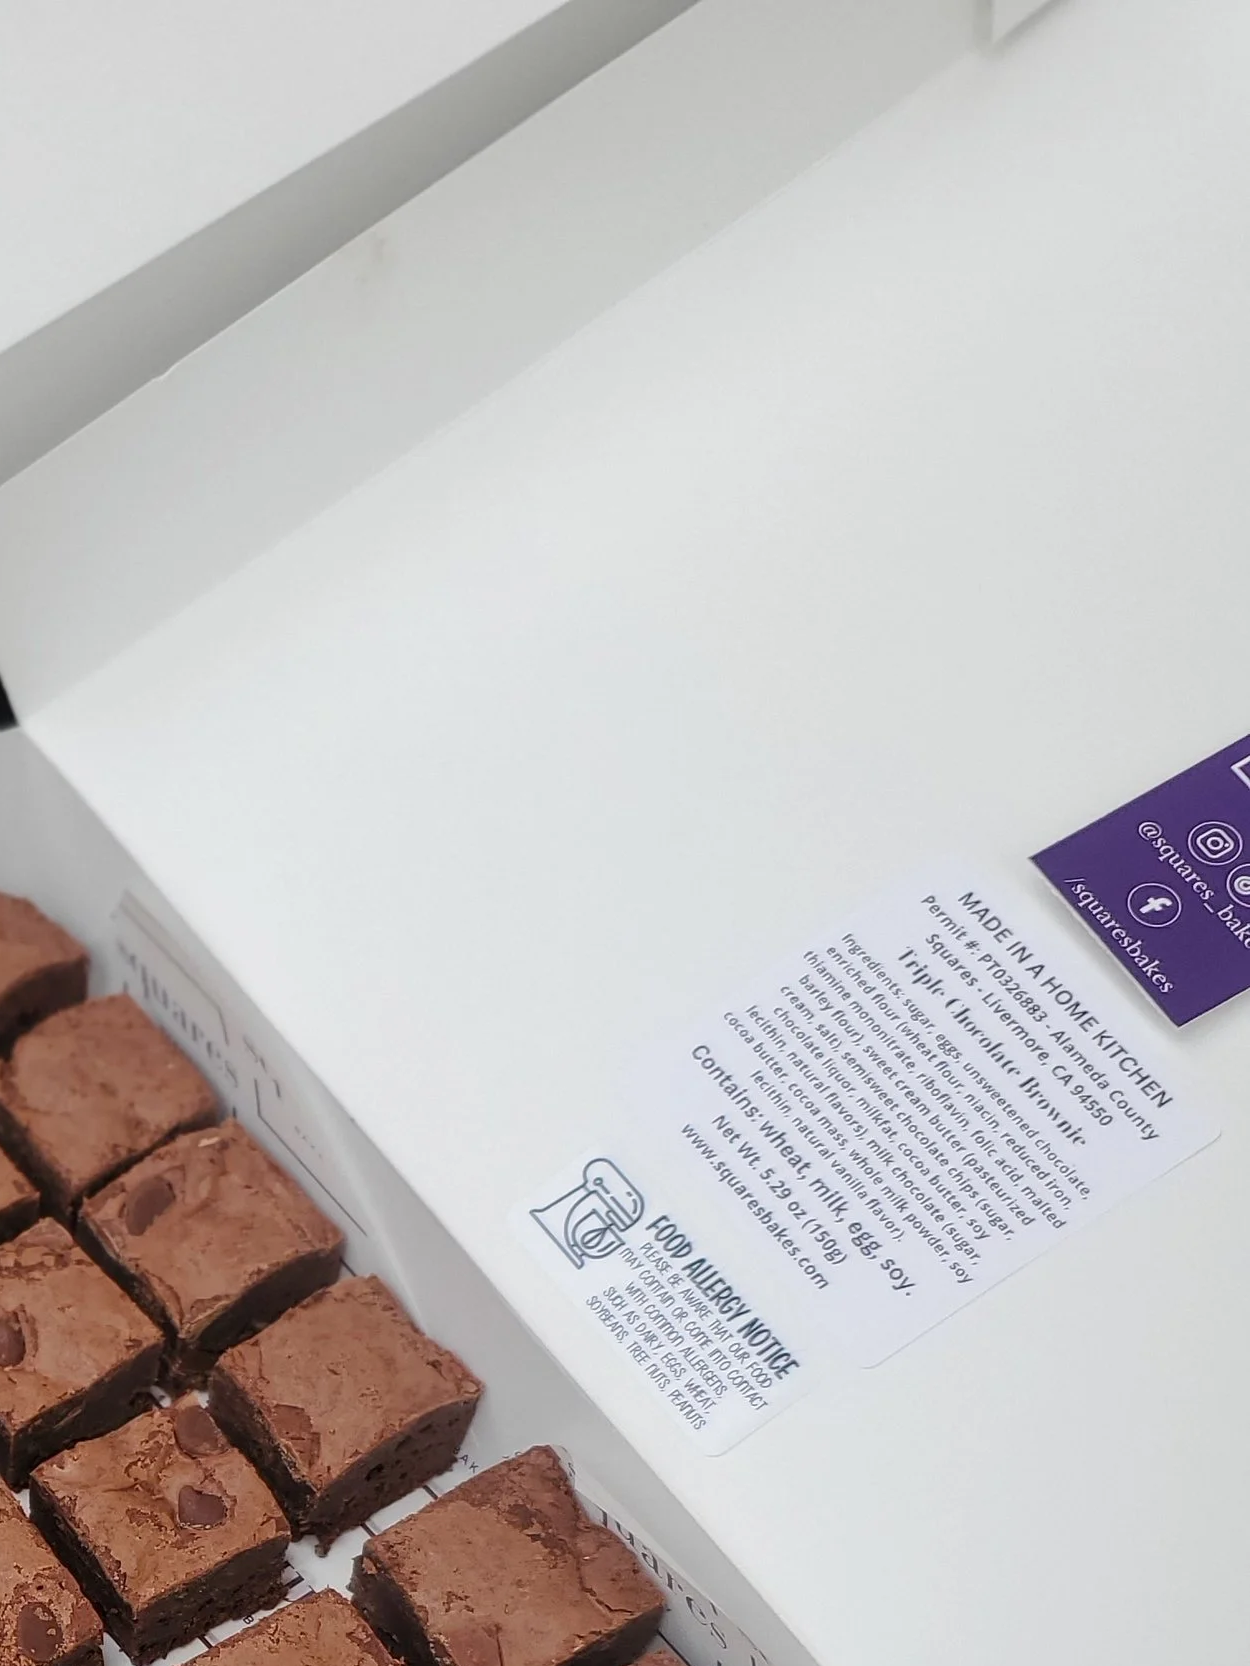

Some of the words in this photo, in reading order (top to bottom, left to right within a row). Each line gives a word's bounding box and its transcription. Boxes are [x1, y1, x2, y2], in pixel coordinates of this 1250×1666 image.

[919, 894, 968, 941] Permit
[962, 939, 981, 955] #:
[975, 952, 1049, 1023] PT0326883
[1047, 1029, 1111, 1090] Alameda
[1107, 1089, 1160, 1141] County
[924, 932, 979, 987] Squares
[980, 991, 1050, 1067] Livermore,
[1050, 1064, 1074, 1087] CA
[1068, 1083, 1114, 1126] 94550
[956, 890, 1014, 944] MADE
[1004, 939, 1035, 964] IN
[1038, 974, 1101, 1033] HOME
[1090, 1028, 1174, 1109] KITCHEN
[1063, 877, 1174, 993] /squaresbakes
[722, 1010, 755, 1045] cocoa
[786, 1082, 822, 1117] cocoa
[847, 1147, 884, 1186] whole
[879, 1184, 909, 1214] milk
[947, 1260, 974, 1284] soy
[772, 1006, 825, 1060] chocolate
[896, 1141, 931, 1177] cocoa
[964, 1217, 991, 1240] soy
[785, 1050, 831, 1094] natural
[864, 1138, 895, 1167] milk
[890, 1165, 945, 1223] chocolate
[797, 973, 835, 1012] barley
[861, 1044, 899, 1081] sweet
[893, 1078, 932, 1117] cream
[926, 1112, 967, 1153] butter
[960, 1151, 1037, 1226] (pasteurized
[802, 949, 852, 1001] thiamine
[968, 1128, 998, 1158] folic
[1019, 1185, 1067, 1229] malted
[825, 945, 877, 995] enriched
[869, 992, 901, 1021] flour
[894, 1020, 938, 1063] (wheat
[998, 1131, 1051, 1181] reduced
[839, 1050, 900, 1112] semisweet
[894, 1110, 950, 1167] chocolate
[946, 1166, 980, 1199] chips
[840, 932, 906, 1000] Ingredients:
[900, 997, 936, 1035] sugar,
[934, 1032, 963, 1064] eggs,
[961, 1061, 1040, 1139] unsweetened
[1033, 1138, 1091, 1200] chocolate,
[896, 945, 945, 997] Triple
[943, 997, 1022, 1076] Chocolate
[1017, 1074, 1087, 1145] Brownie
[679, 1122, 830, 1290] www.squaresbakes.com
[690, 1043, 765, 1123] Contains:
[757, 1119, 812, 1181] wheat,
[807, 1176, 849, 1224] milk,
[846, 1220, 884, 1260] egg,
[878, 1257, 917, 1297] soy.
[710, 1113, 742, 1145] Net
[736, 1139, 761, 1171] Wt.
[758, 1166, 793, 1200] 5.29
[786, 1199, 808, 1221] oz
[800, 1217, 848, 1265] (150g)
[790, 1116, 837, 1160] natural
[829, 1158, 868, 1200] vanilla
[644, 1213, 693, 1259] FOOD
[680, 1256, 752, 1322] ALLERGY
[735, 1316, 801, 1380] NOTICE
